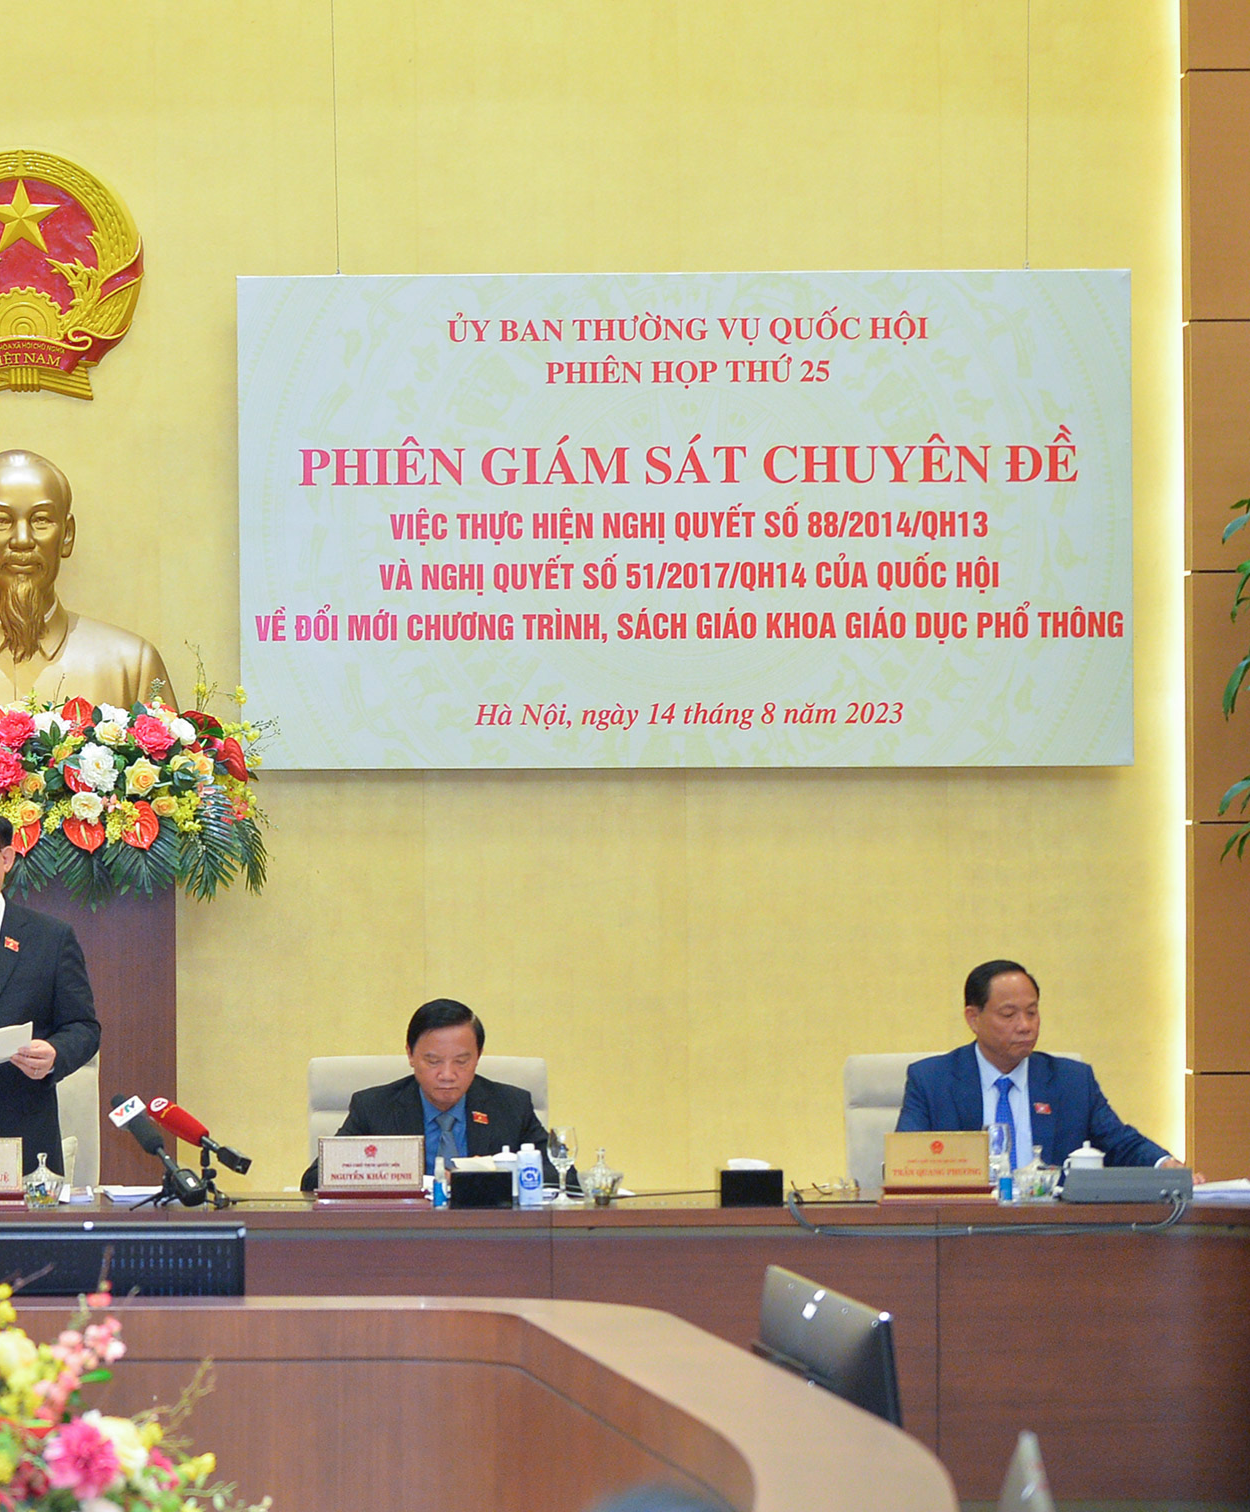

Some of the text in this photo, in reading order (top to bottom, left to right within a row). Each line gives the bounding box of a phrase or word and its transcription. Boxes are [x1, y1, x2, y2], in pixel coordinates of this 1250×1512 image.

[448, 306, 929, 347] ỦY BAN THƯỜNG VỤ QUỐC HỘI
[23, 352, 61, 366] NAM
[546, 353, 831, 389] PHIÊN HỌP THỨ 25
[298, 425, 1080, 487] PHIÊN GIÁM SÁT CHUYÊN ĐỀ
[390, 502, 989, 546] VIỆC THỰC HIỆN NGHỊ QUYẾT SỐ 88/2014/QH13
[379, 552, 999, 596] VÀ NGHỊ QUYẾT SỐ 51/2017/QH14 CỦA QUỐC HỘI
[255, 600, 1124, 645] VỀ ĐỔI MỚI CHƯƠNG TRÌNH, SÁCH GIÁO KHOA GIÁO DỤC PHỔ THÔNG
[474, 703, 904, 732] Hà Nội, ngày 14 tháng 8 năm 2023
[113, 1100, 135, 1117] VTV
